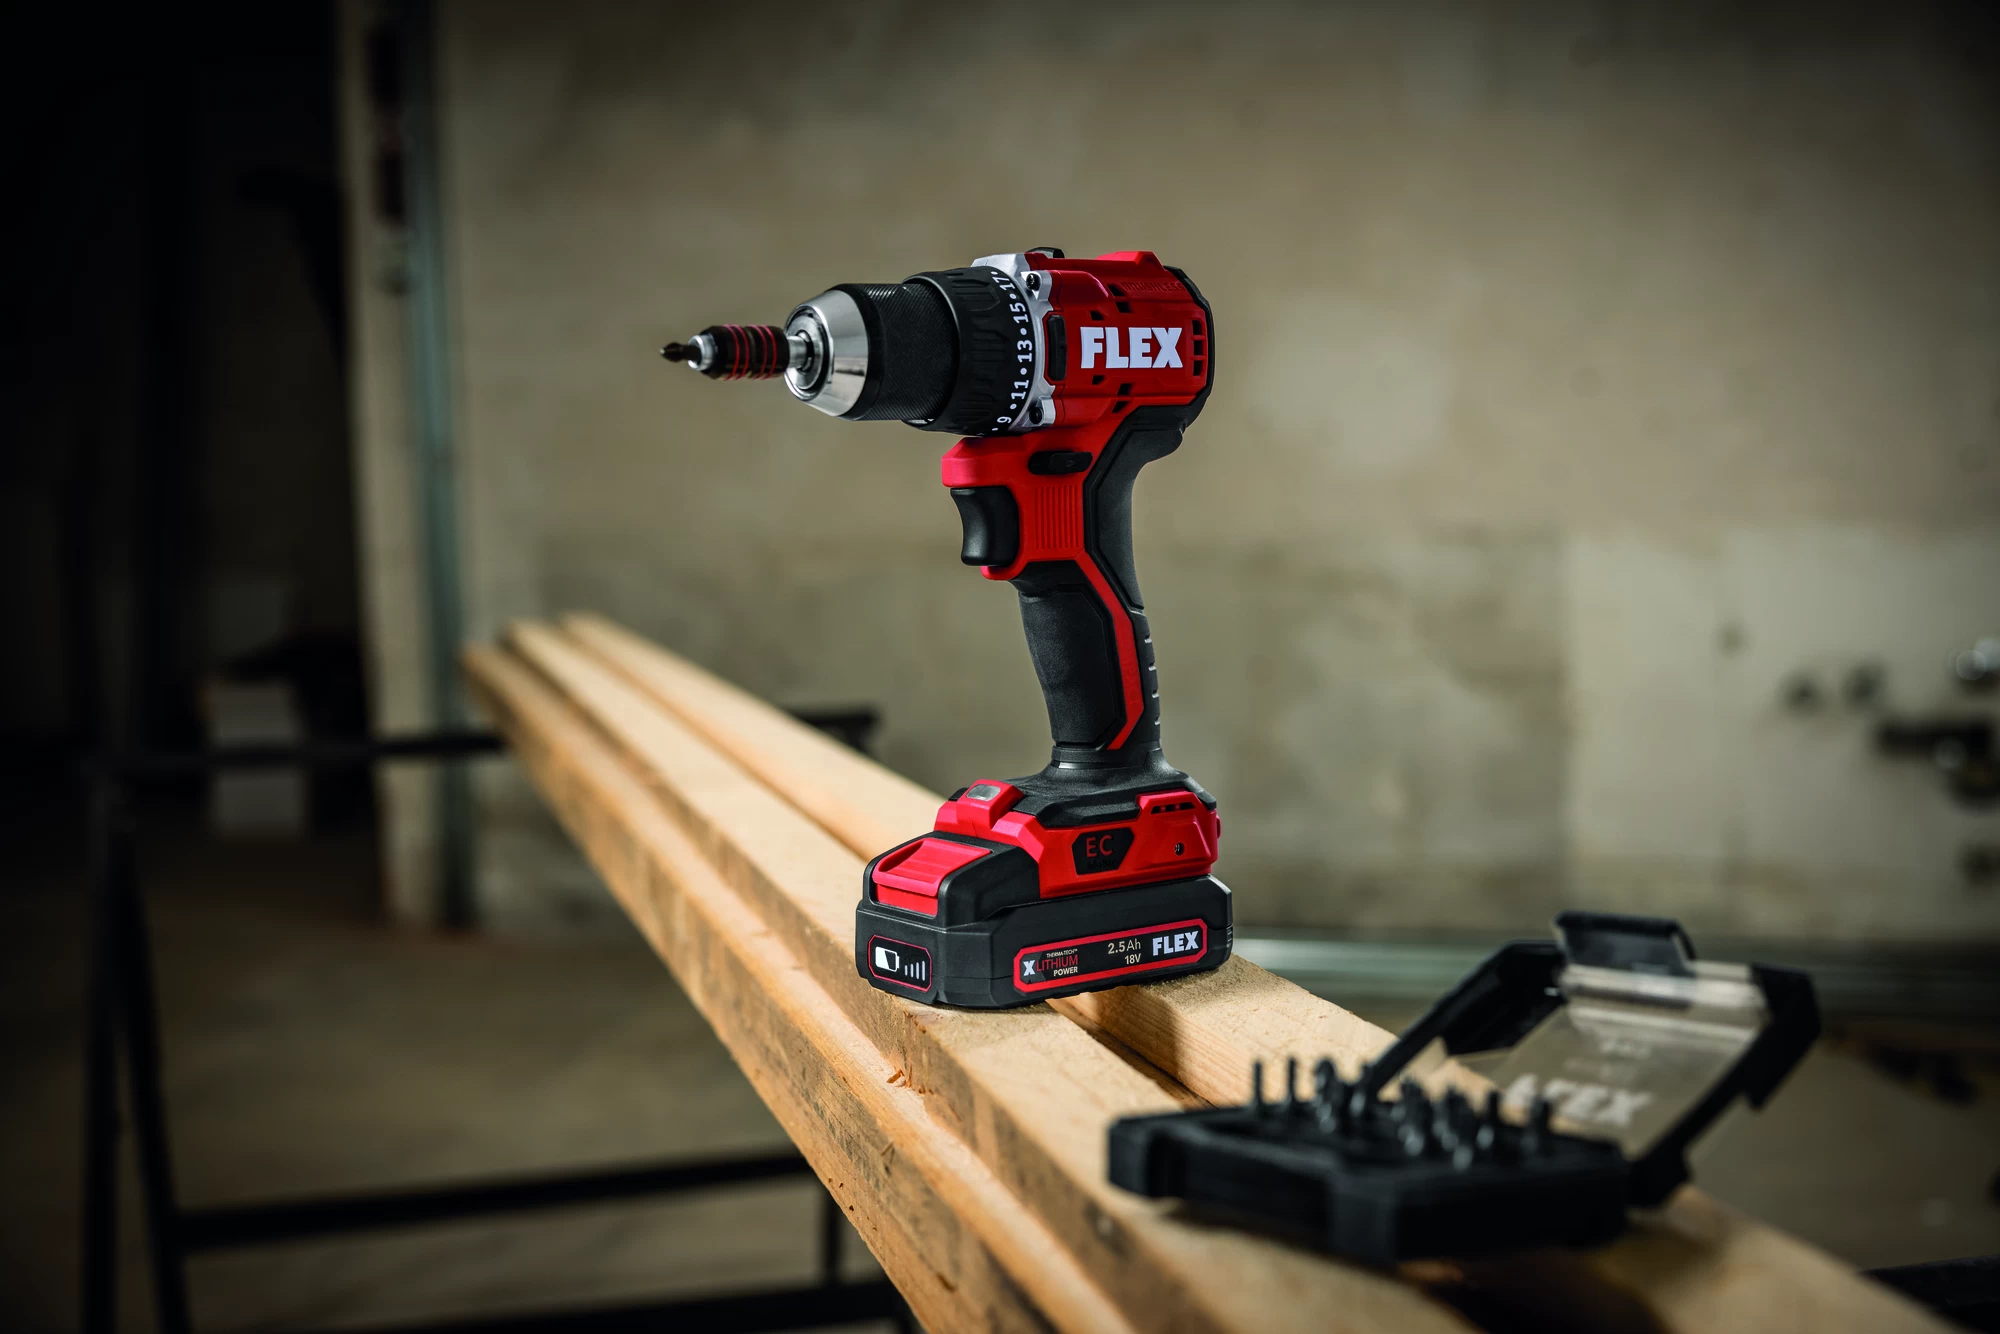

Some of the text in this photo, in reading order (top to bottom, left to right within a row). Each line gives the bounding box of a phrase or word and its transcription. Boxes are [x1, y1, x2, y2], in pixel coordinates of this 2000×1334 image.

[992, 276, 1033, 424] 9 11 13 15 17
[1080, 326, 1183, 369] FLEX
[1086, 834, 1114, 857] EC
[1152, 930, 1199, 957] FLEX
[1053, 965, 1079, 977] POWER
[1124, 952, 1142, 965] 18V
